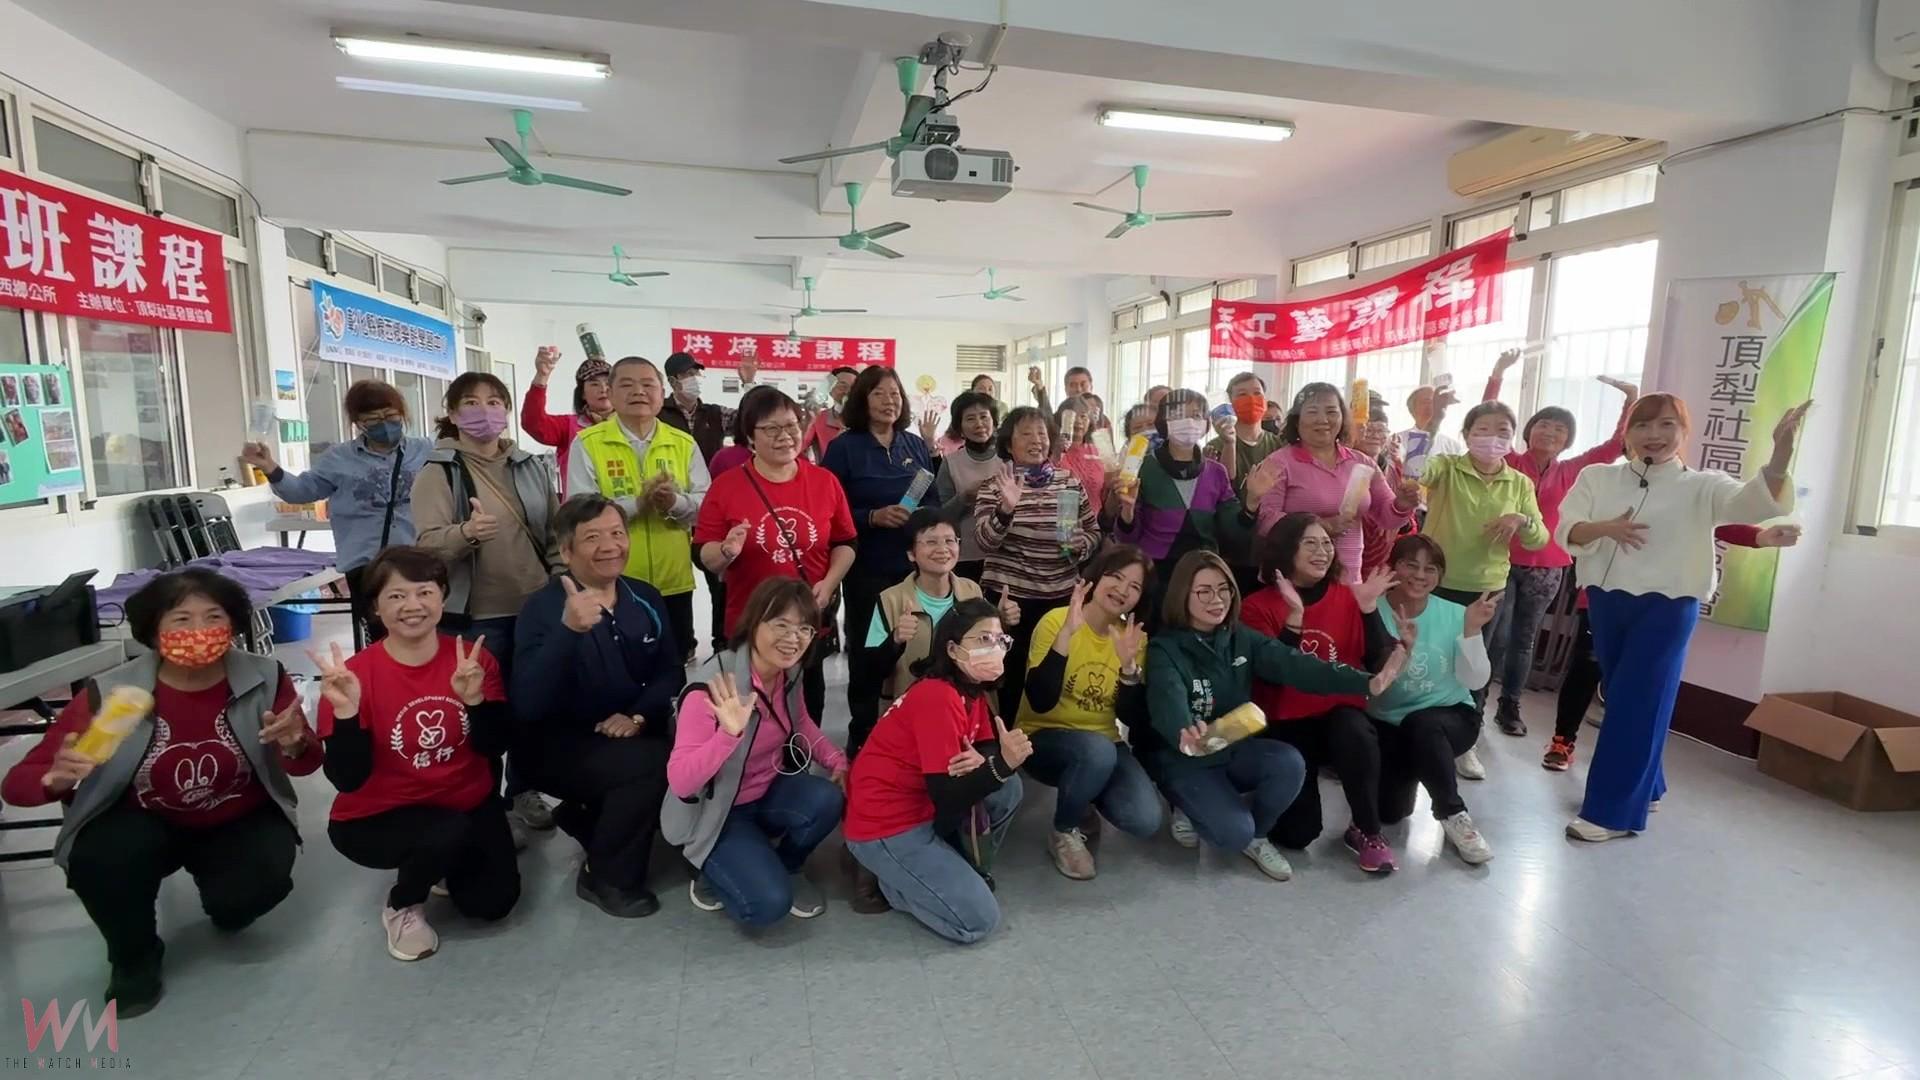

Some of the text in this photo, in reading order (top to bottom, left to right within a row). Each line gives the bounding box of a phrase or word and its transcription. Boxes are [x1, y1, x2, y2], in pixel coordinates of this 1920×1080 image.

[0, 188, 210, 303] 班課程
[682, 333, 887, 361] 烘焙班課程
